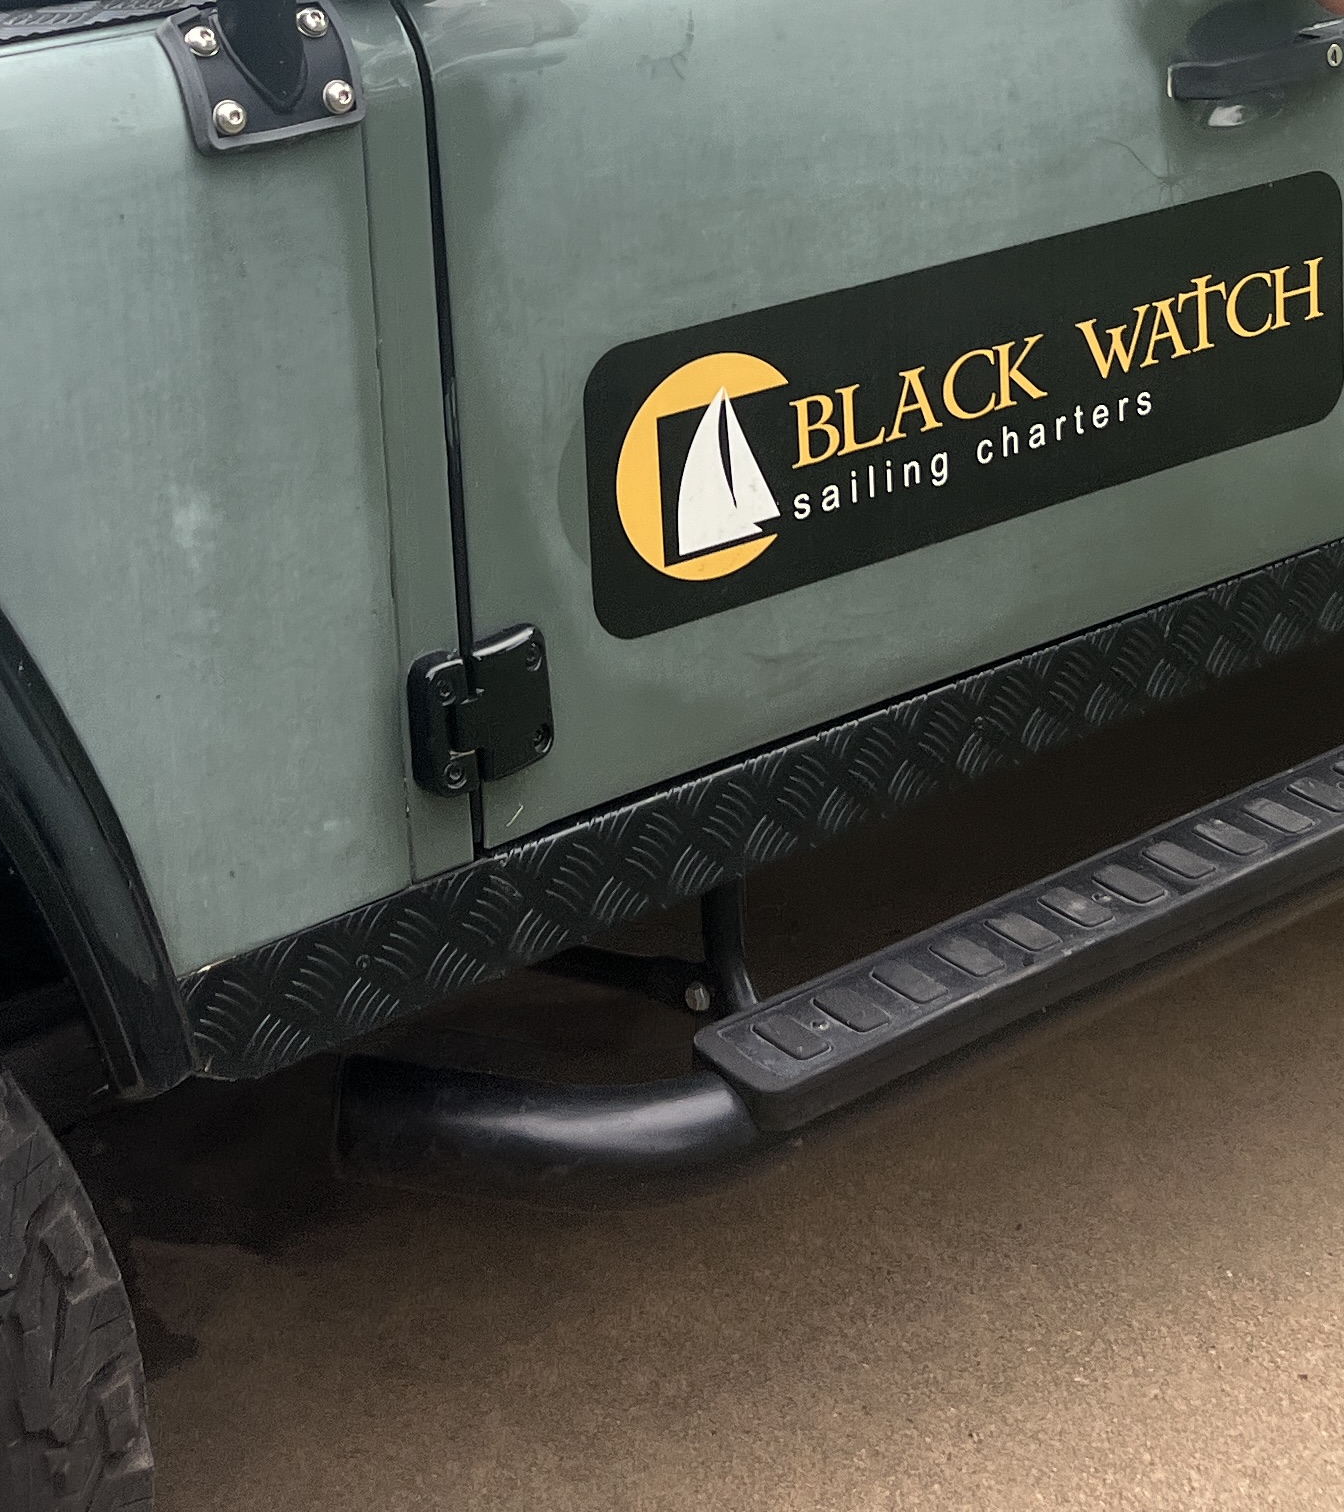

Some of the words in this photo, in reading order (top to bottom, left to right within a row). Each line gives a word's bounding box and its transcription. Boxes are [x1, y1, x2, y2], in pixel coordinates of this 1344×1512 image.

[788, 333, 1048, 470] BLACK
[1075, 257, 1324, 380] WATCH
[793, 451, 949, 520] sailing
[976, 391, 1153, 465] charters
